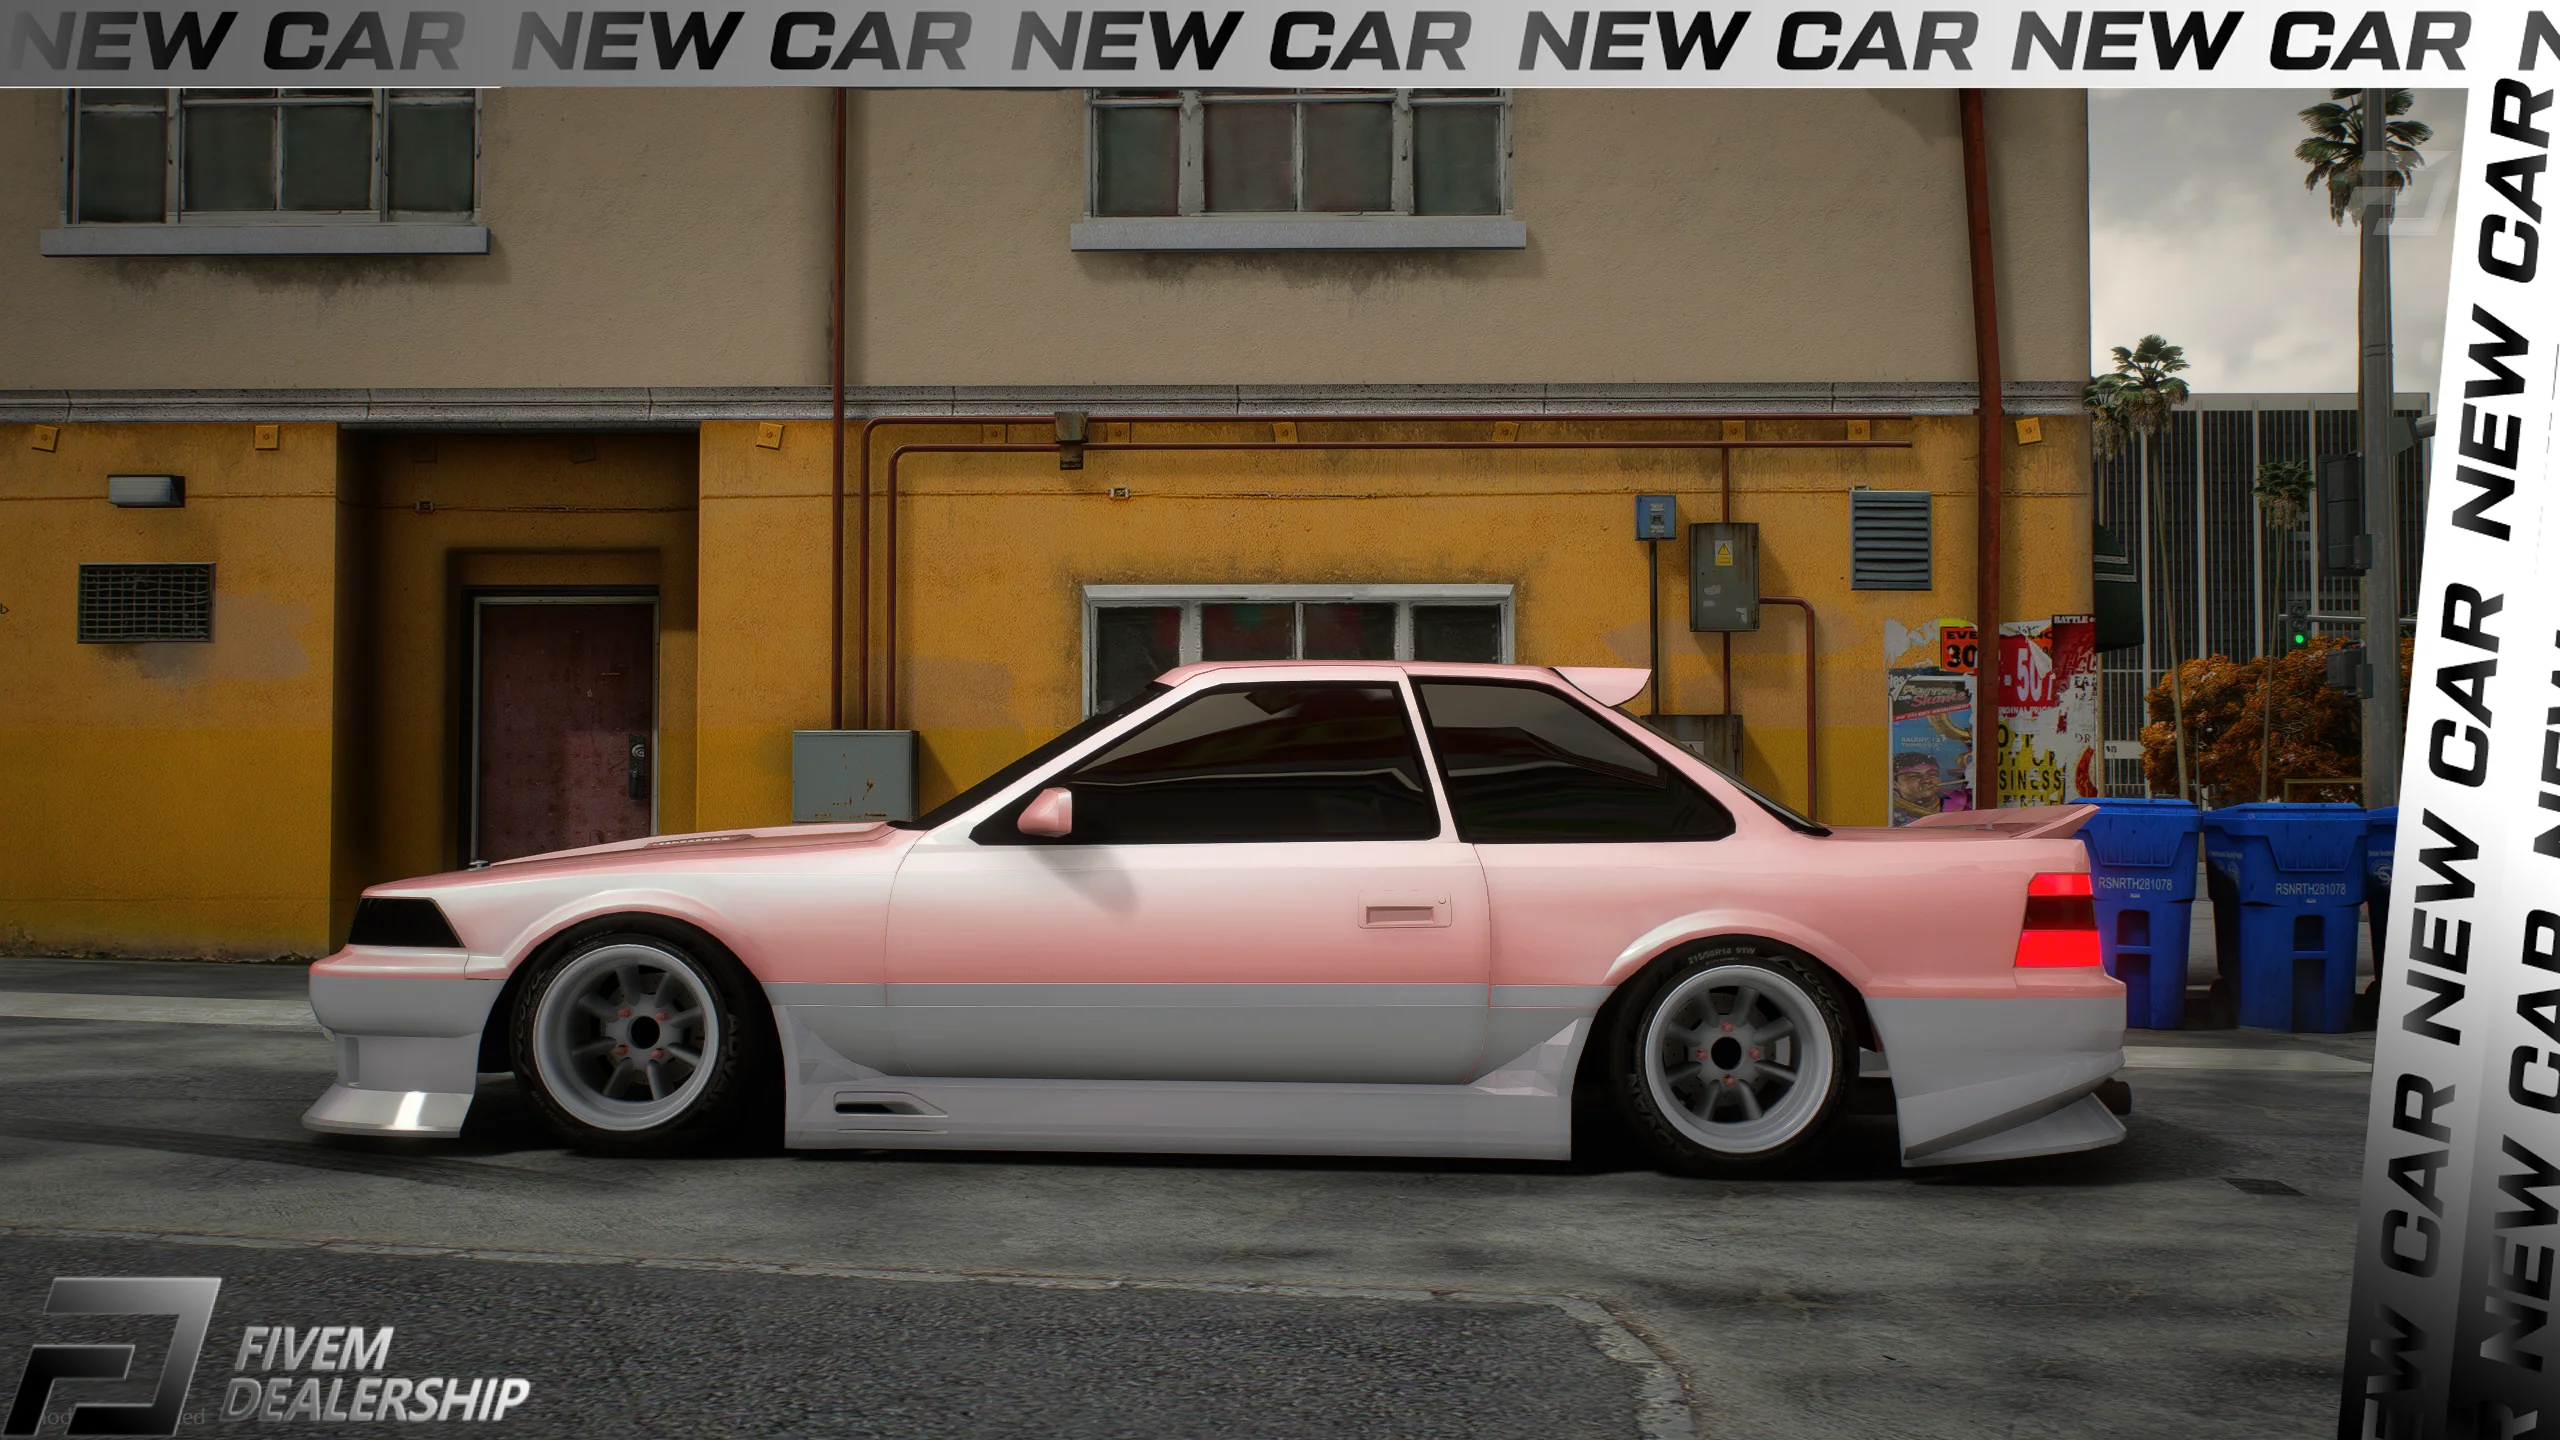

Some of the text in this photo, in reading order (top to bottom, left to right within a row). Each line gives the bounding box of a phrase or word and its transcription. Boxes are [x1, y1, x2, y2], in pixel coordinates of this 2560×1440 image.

[2053, 615, 2089, 625] BATTLE
[1999, 769, 2062, 791] SINESS
[2098, 876, 2173, 891] RSNRTH281078
[2275, 882, 2346, 896] RSNRTH281078
